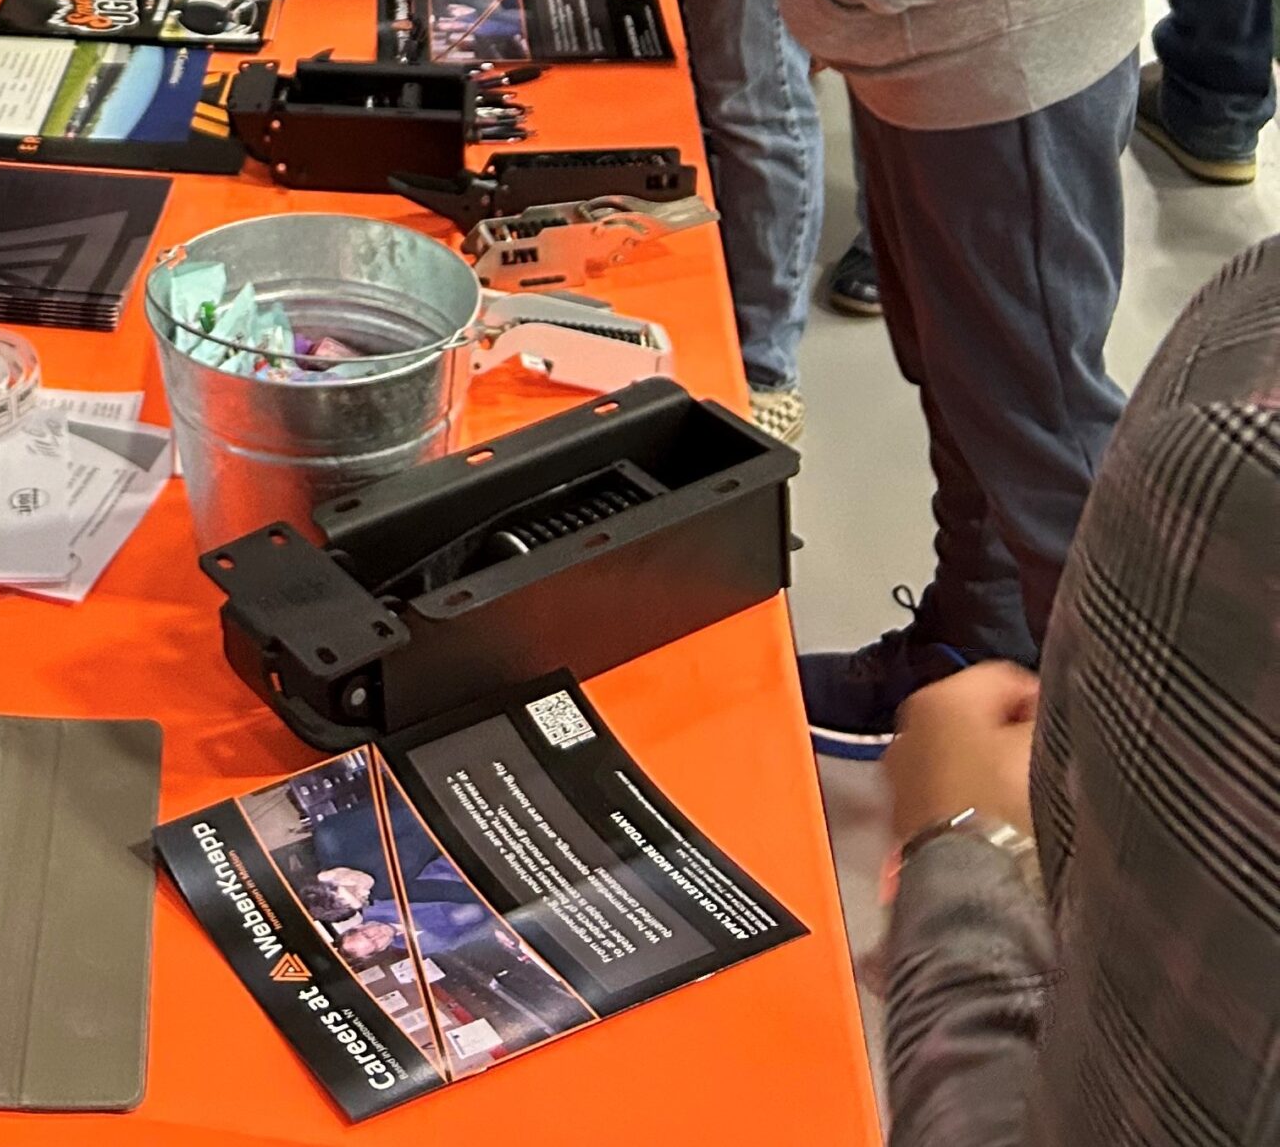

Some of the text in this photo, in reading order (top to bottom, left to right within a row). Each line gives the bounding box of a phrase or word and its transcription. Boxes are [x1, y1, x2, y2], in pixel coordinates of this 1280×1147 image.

[456, 770, 469, 781] at
[451, 784, 495, 829] operations
[464, 782, 489, 810] career
[483, 830, 503, 847] and
[491, 817, 538, 871] management,
[492, 762, 660, 944] We have immediate openings, and are looking for
[229, 850, 249, 879] Motion
[497, 805, 636, 953] Weber Knapp is centered around growth.
[504, 852, 543, 893] machining
[610, 811, 749, 939] APPLY OR LEARN MORE TODAY!
[535, 871, 571, 905] business
[594, 867, 673, 938] qualified candidates!
[251, 889, 282, 929] Innovation
[546, 899, 592, 943] engineering
[563, 904, 579, 913] of
[575, 912, 606, 939] aspects
[193, 823, 395, 1089] Careers at WeberKnapp
[589, 942, 613, 963] From
[601, 939, 616, 948] all
[613, 948, 625, 958] to
[342, 1008, 354, 1019] NY
[352, 1018, 387, 1052] Jamestown,
[386, 1058, 410, 1080] Based
